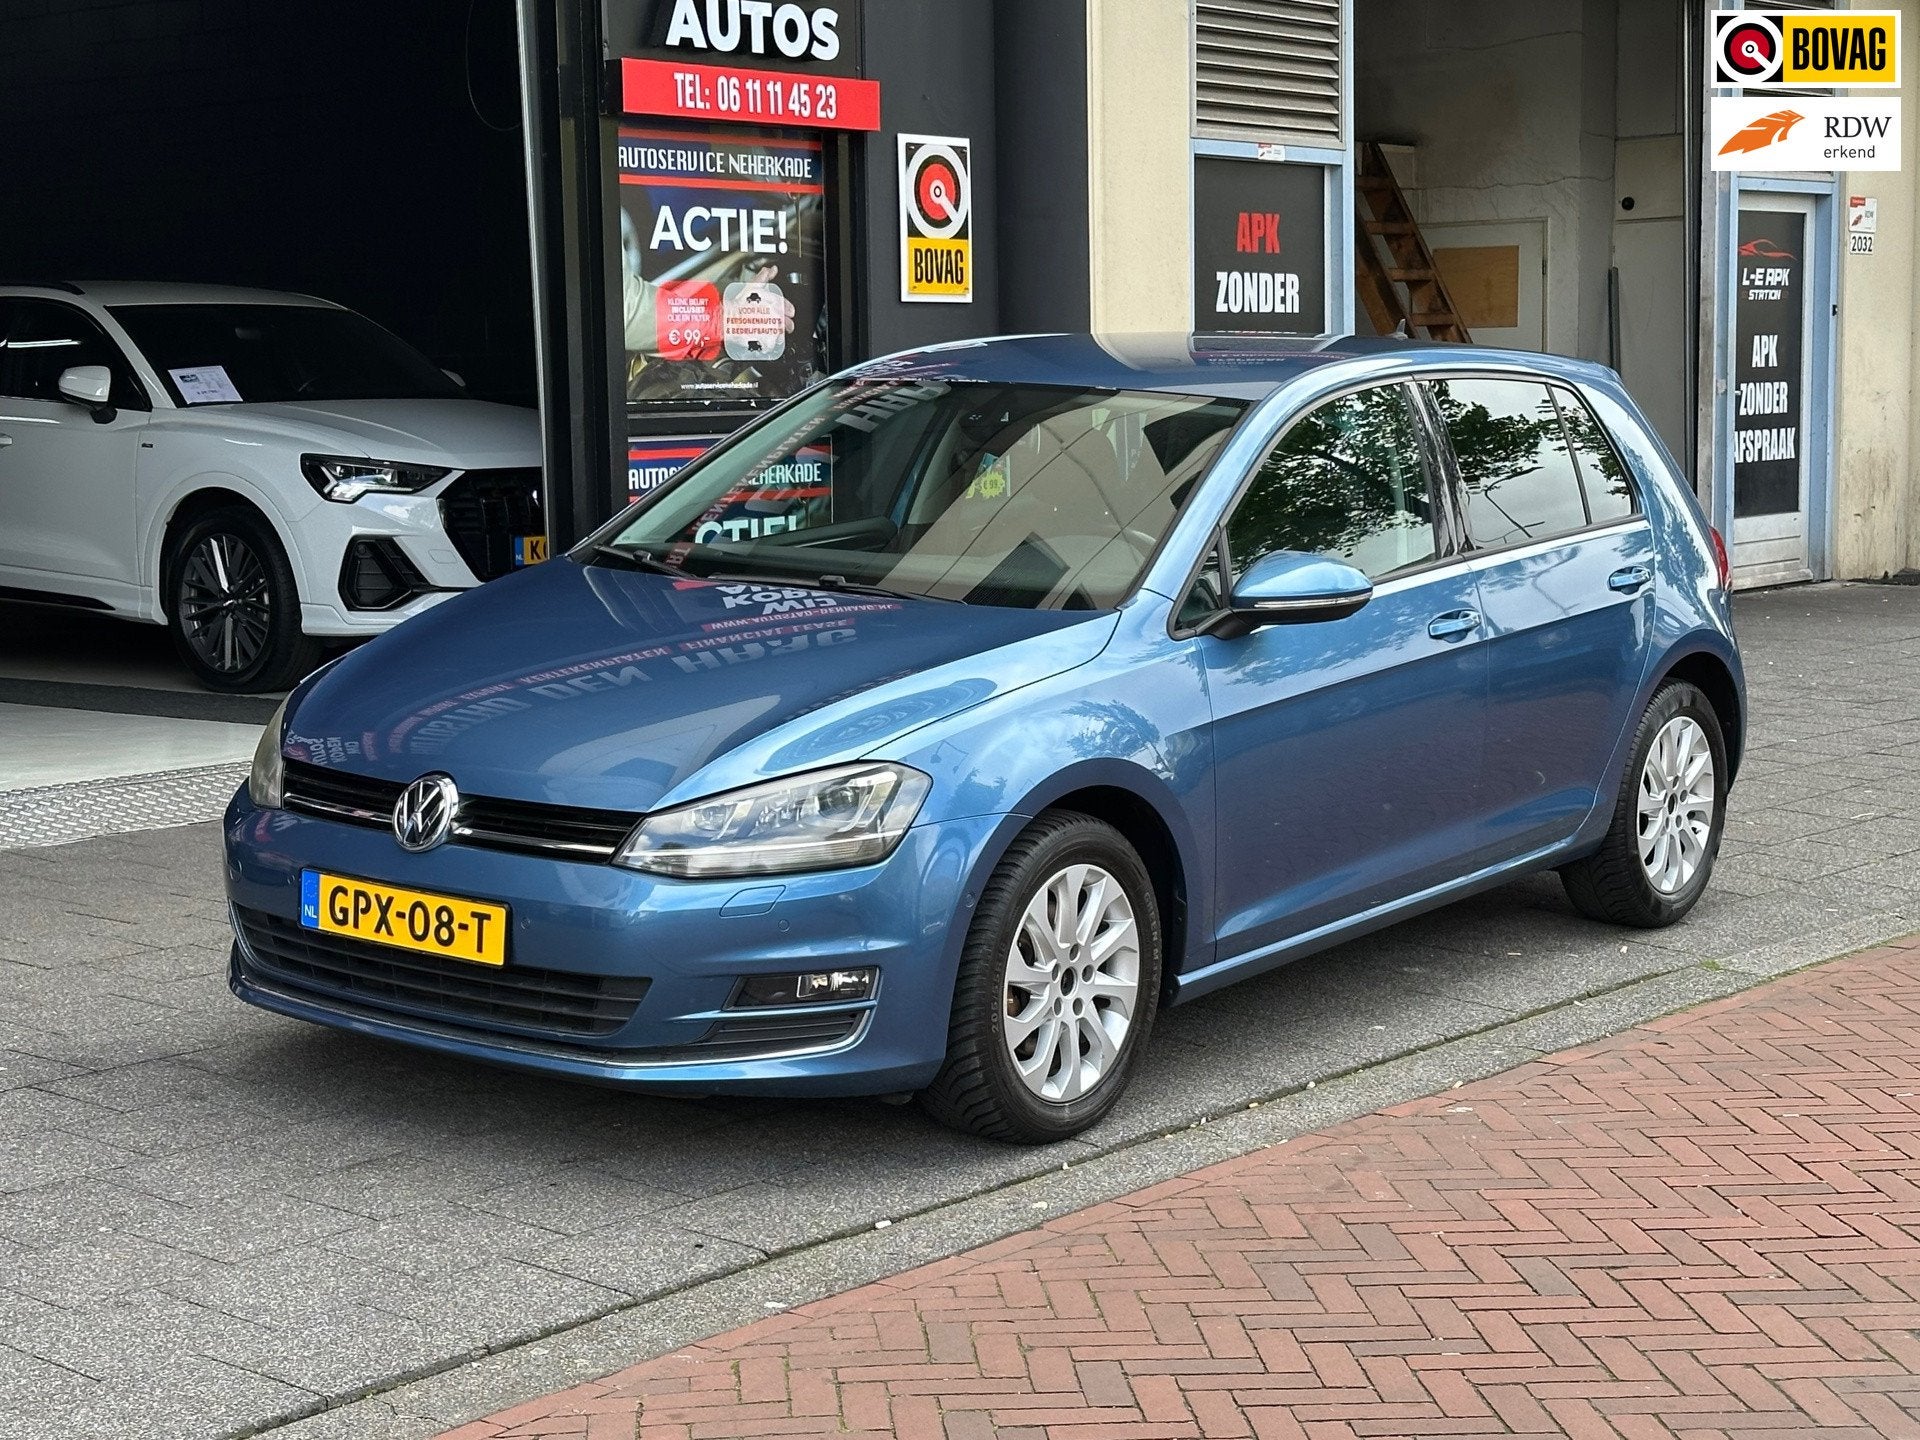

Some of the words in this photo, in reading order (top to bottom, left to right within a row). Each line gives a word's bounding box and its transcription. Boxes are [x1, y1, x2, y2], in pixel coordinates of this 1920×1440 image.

[665, 0, 840, 61] AUTOS
[673, 72, 711, 110] TEL:
[717, 75, 741, 112] 06
[745, 79, 762, 114] 11
[766, 81, 783, 115] 11
[788, 82, 811, 117] 45
[815, 84, 837, 120] 23
[618, 146, 725, 173] AUTOSERVICE
[729, 153, 812, 179] NEHERKADE
[650, 205, 788, 254] ACTIE!
[1236, 212, 1280, 254] APK
[1851, 235, 1873, 252] 2032
[913, 247, 965, 284] BOVAG
[1742, 268, 1765, 286] L-E
[1765, 268, 1790, 286] APK
[1215, 271, 1300, 314] ZONDER
[1748, 289, 1782, 301] STATION
[1751, 334, 1778, 368] APK
[1739, 381, 1788, 416] ZONDER
[1734, 427, 1796, 464] AFSPRAAK
[629, 465, 691, 490] AUTO
[746, 463, 822, 485] EHERKADE
[304, 904, 317, 919] NL
[328, 885, 492, 954] GPX-08-T
